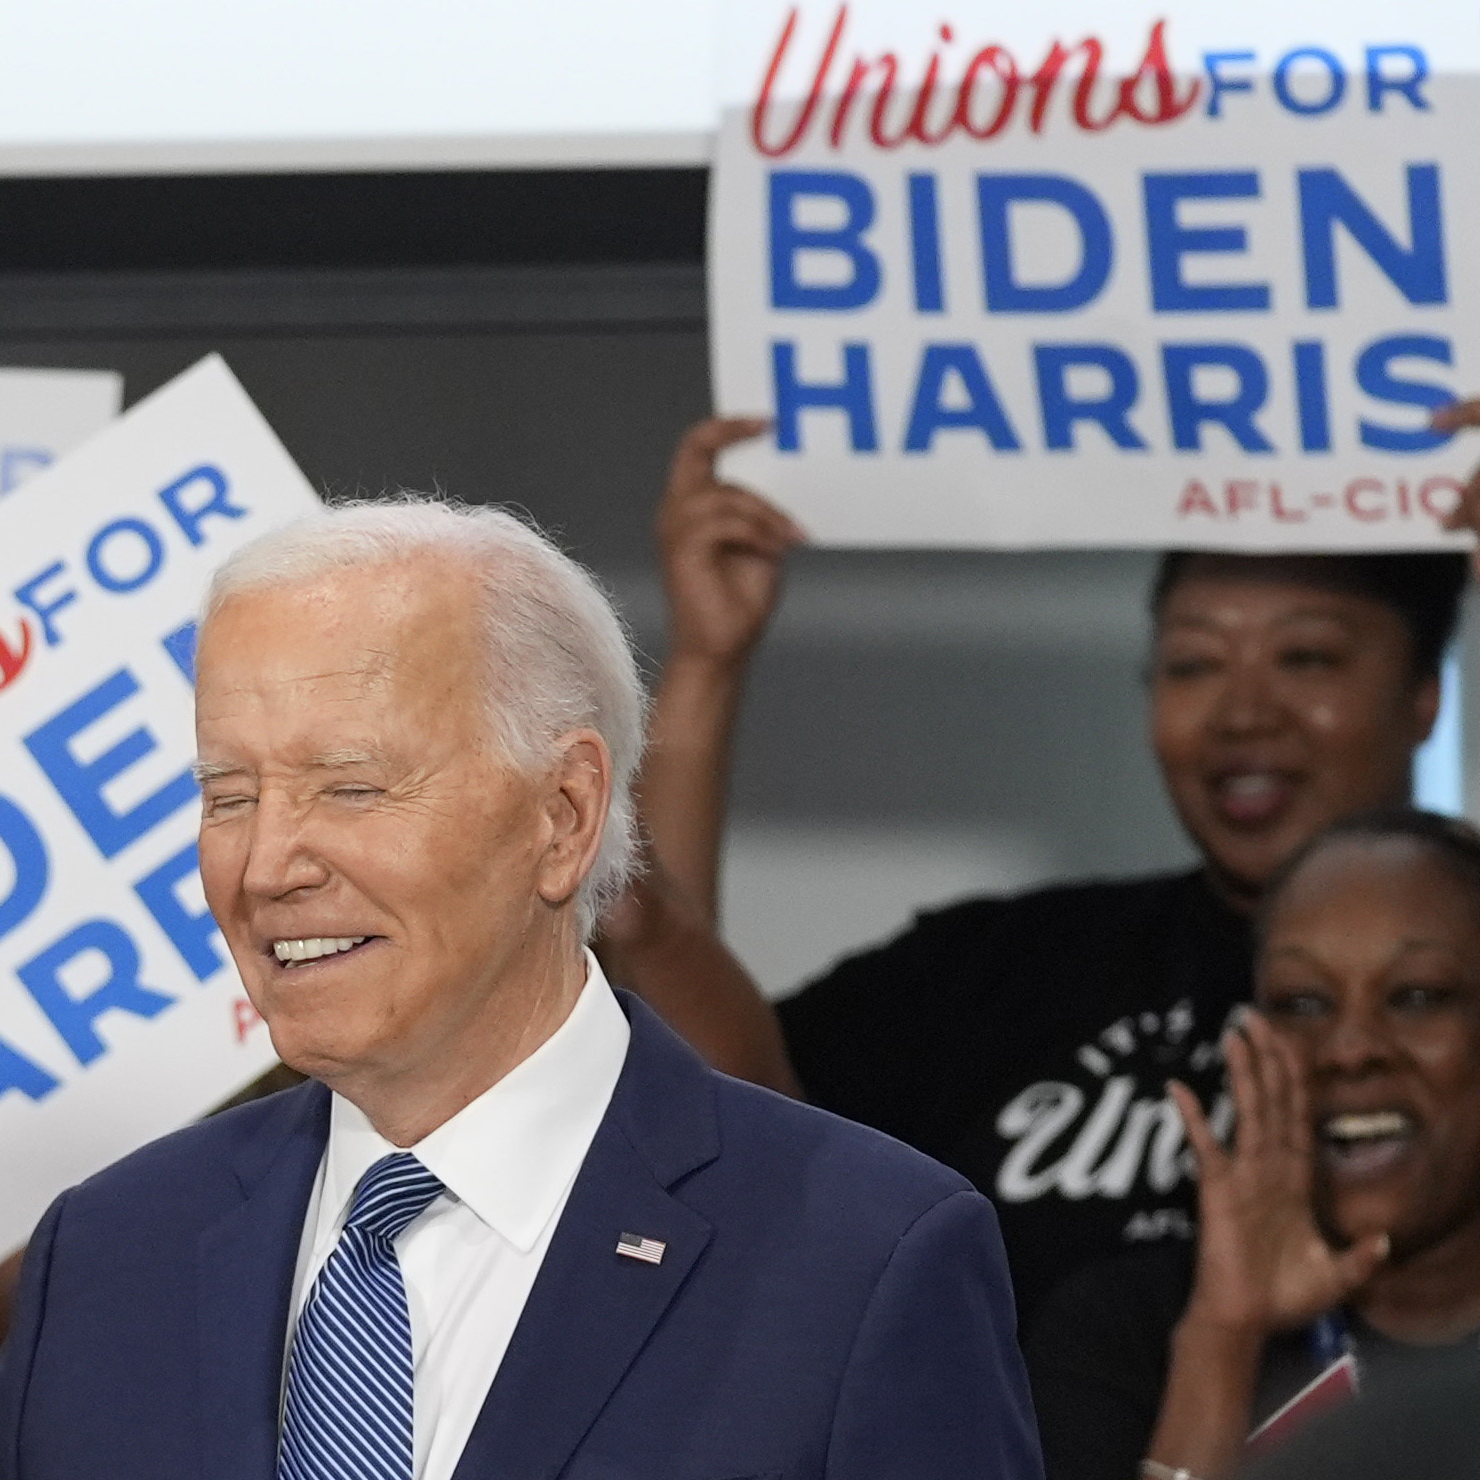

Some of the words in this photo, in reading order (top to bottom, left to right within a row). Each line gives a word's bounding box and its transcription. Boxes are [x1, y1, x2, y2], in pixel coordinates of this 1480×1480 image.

[750, 3, 1201, 159] Unions
[1201, 43, 1433, 118] FOR
[767, 162, 1449, 317] BIDEN
[770, 331, 1459, 456] HARRIS
[14, 462, 251, 648] FOR
